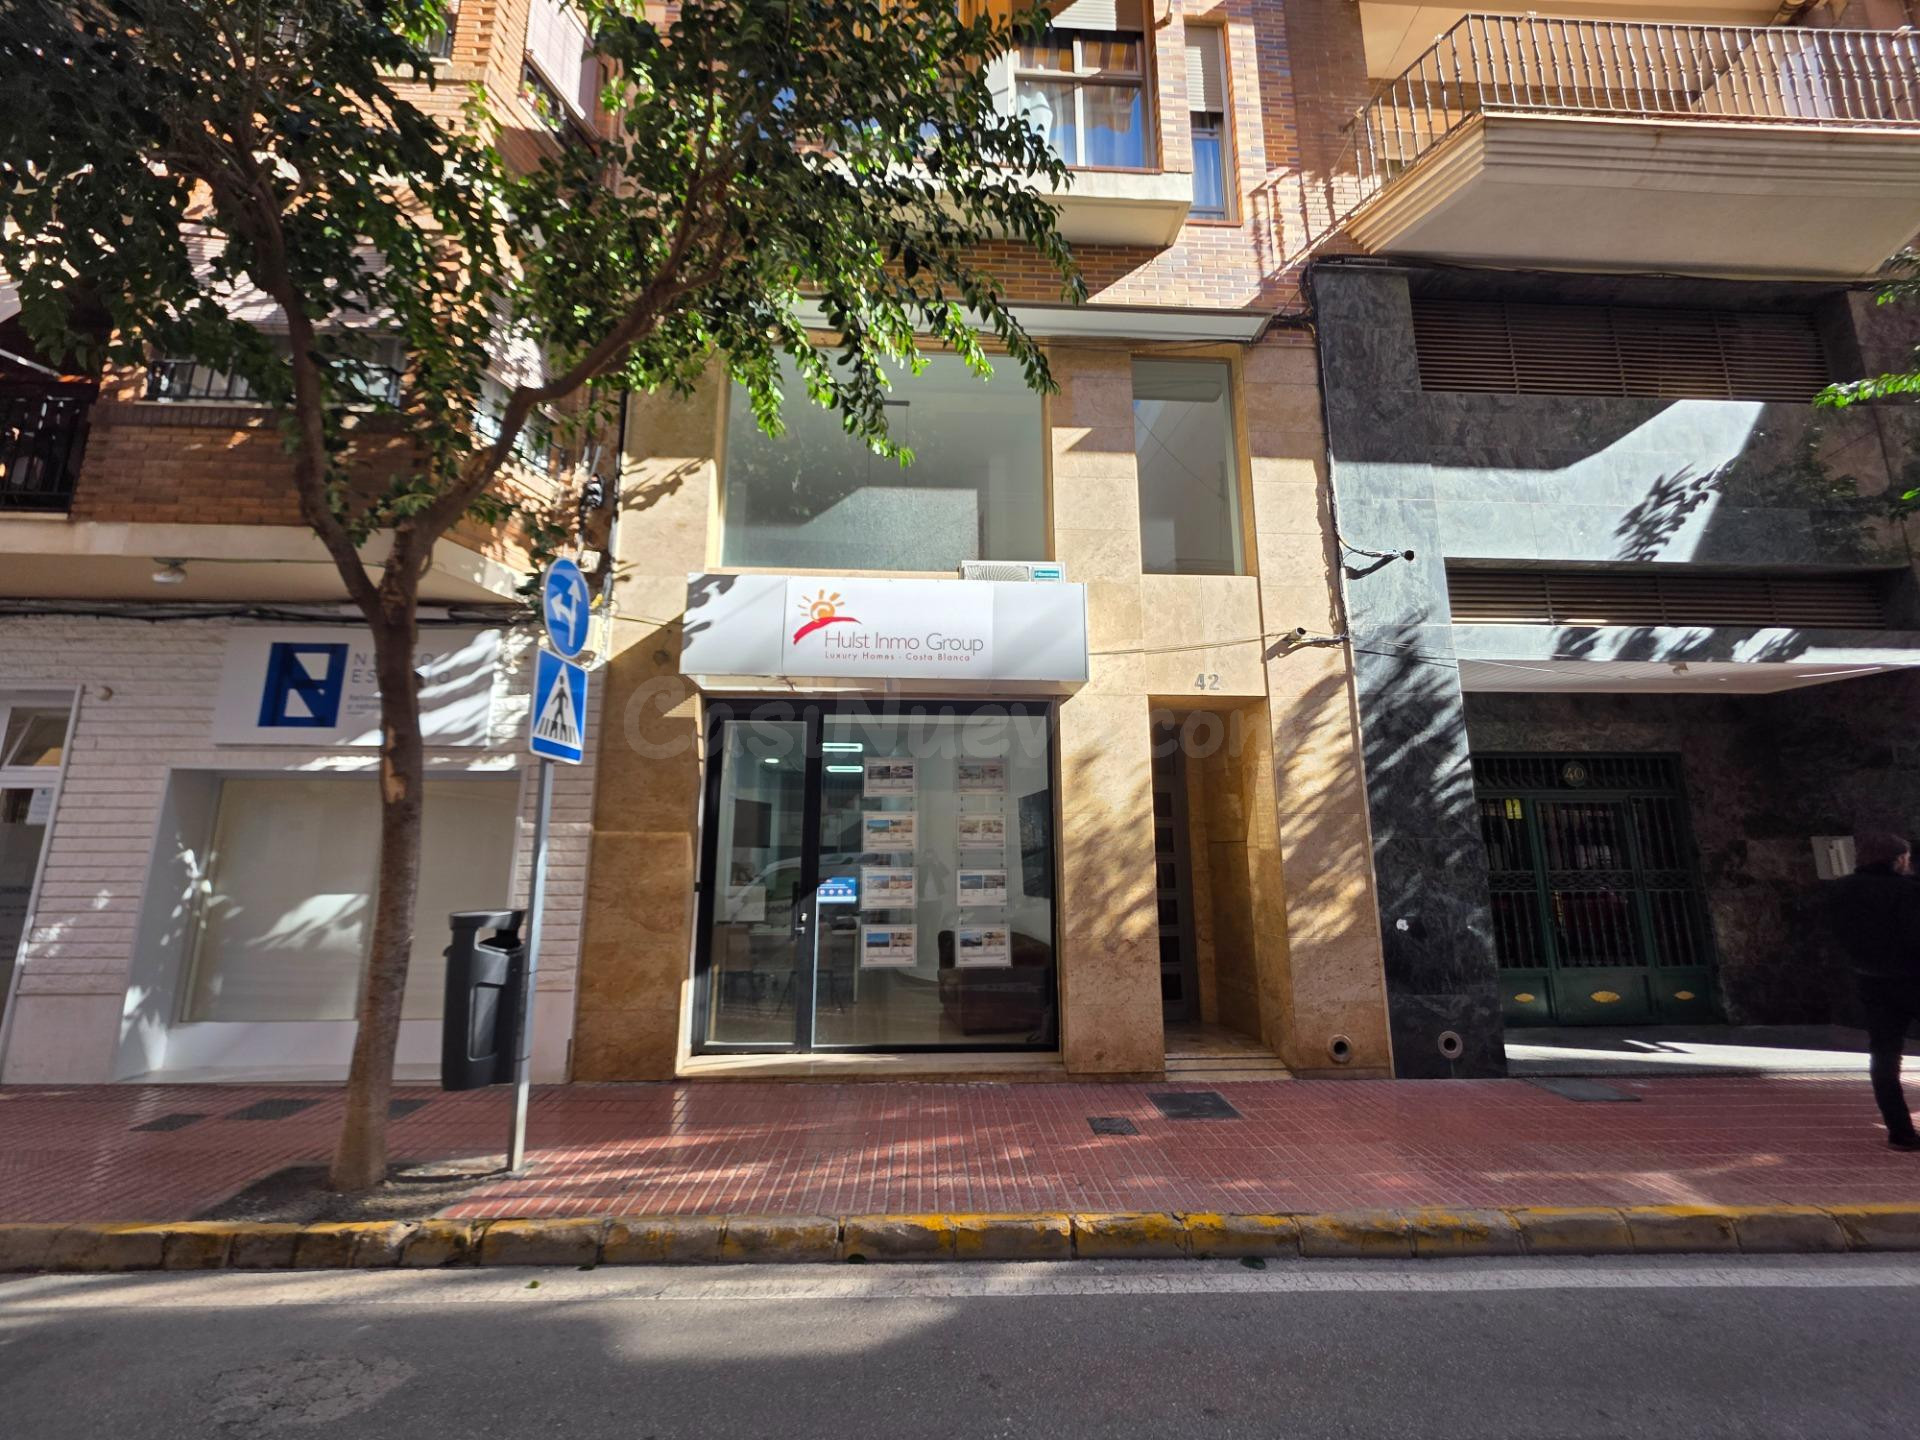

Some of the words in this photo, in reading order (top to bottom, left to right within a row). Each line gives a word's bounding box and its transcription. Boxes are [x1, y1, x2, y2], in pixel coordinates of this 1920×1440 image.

[824, 630, 871, 649] Hulst
[875, 631, 920, 650] Inmo
[926, 632, 984, 656] Group
[824, 651, 858, 662] Luxury
[862, 652, 895, 661] Homes
[905, 652, 933, 661] Costa
[937, 652, 971, 662] Blanca
[1194, 673, 1220, 690] 42
[1563, 767, 1584, 780] 40
